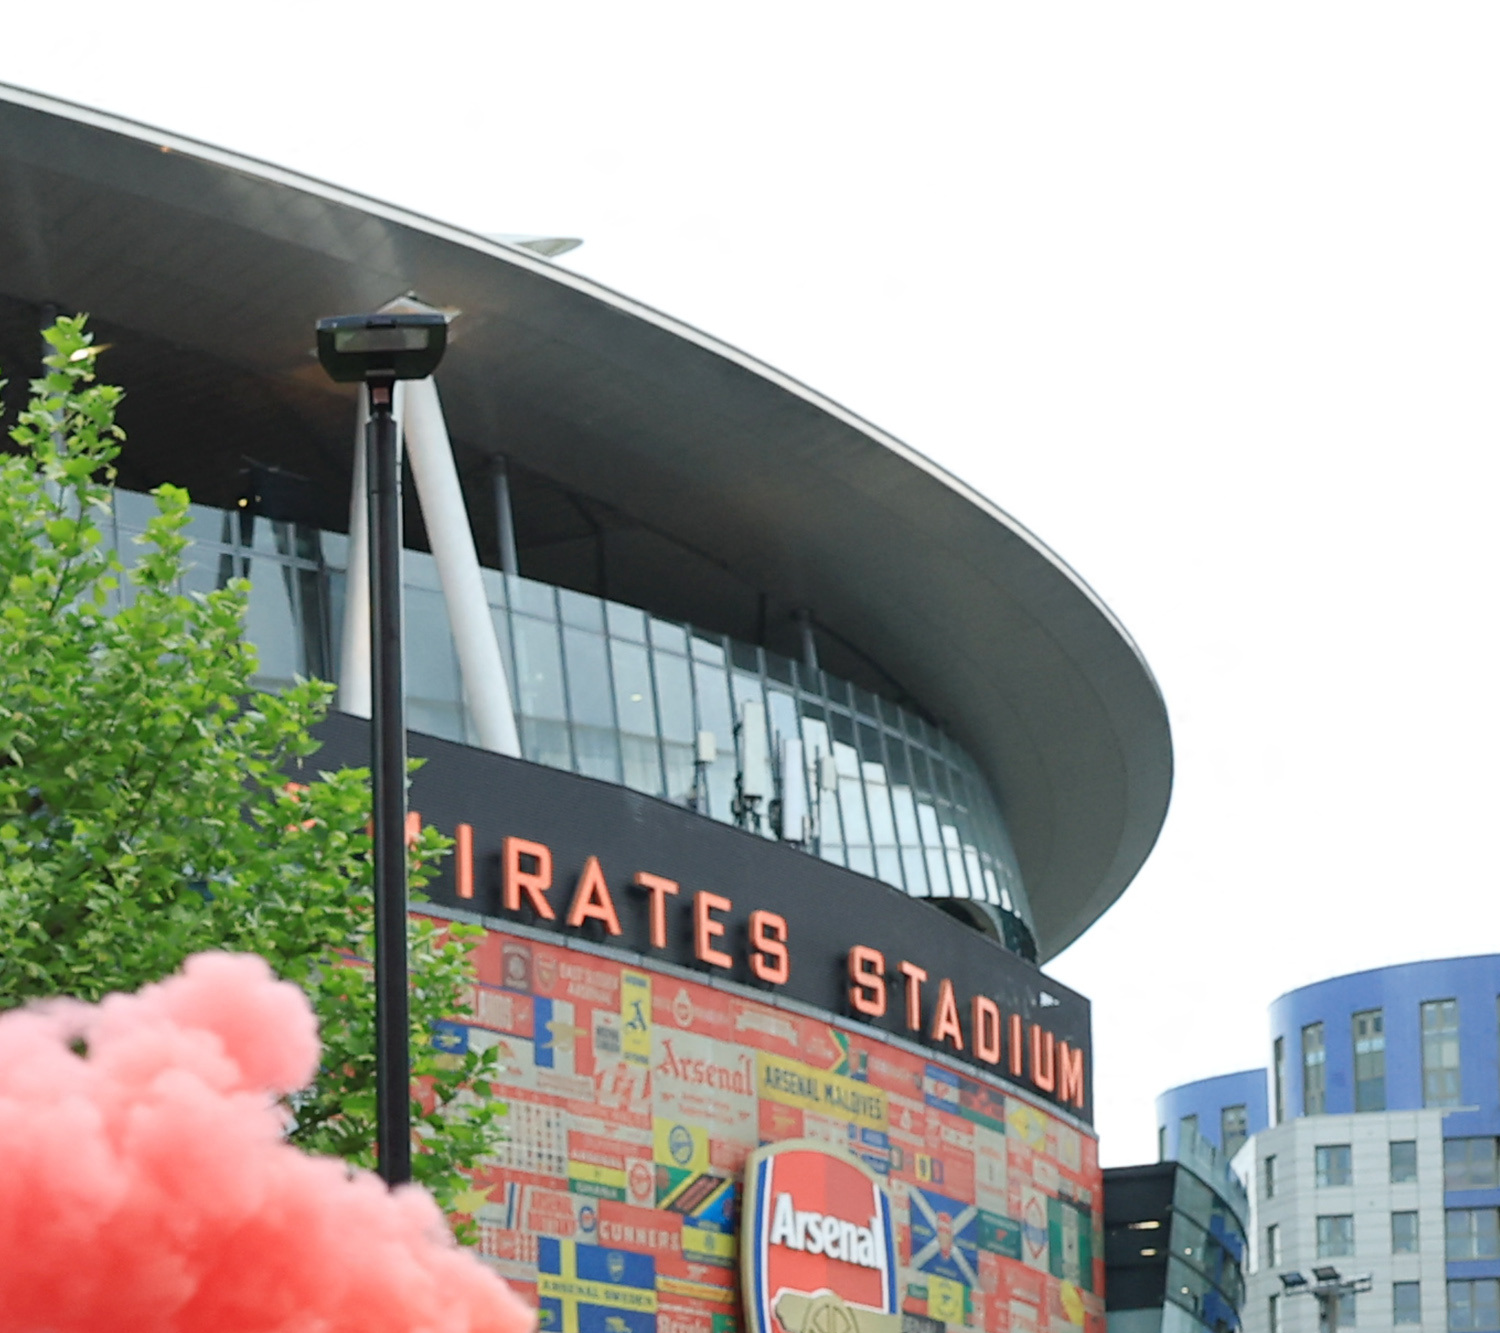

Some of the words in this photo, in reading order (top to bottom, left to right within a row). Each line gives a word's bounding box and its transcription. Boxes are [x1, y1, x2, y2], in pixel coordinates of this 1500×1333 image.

[405, 810, 792, 985] IRATES
[846, 944, 1085, 1109] STADIUM
[599, 1219, 681, 1252] GUNNERS
[769, 1191, 884, 1271] Arsenal
